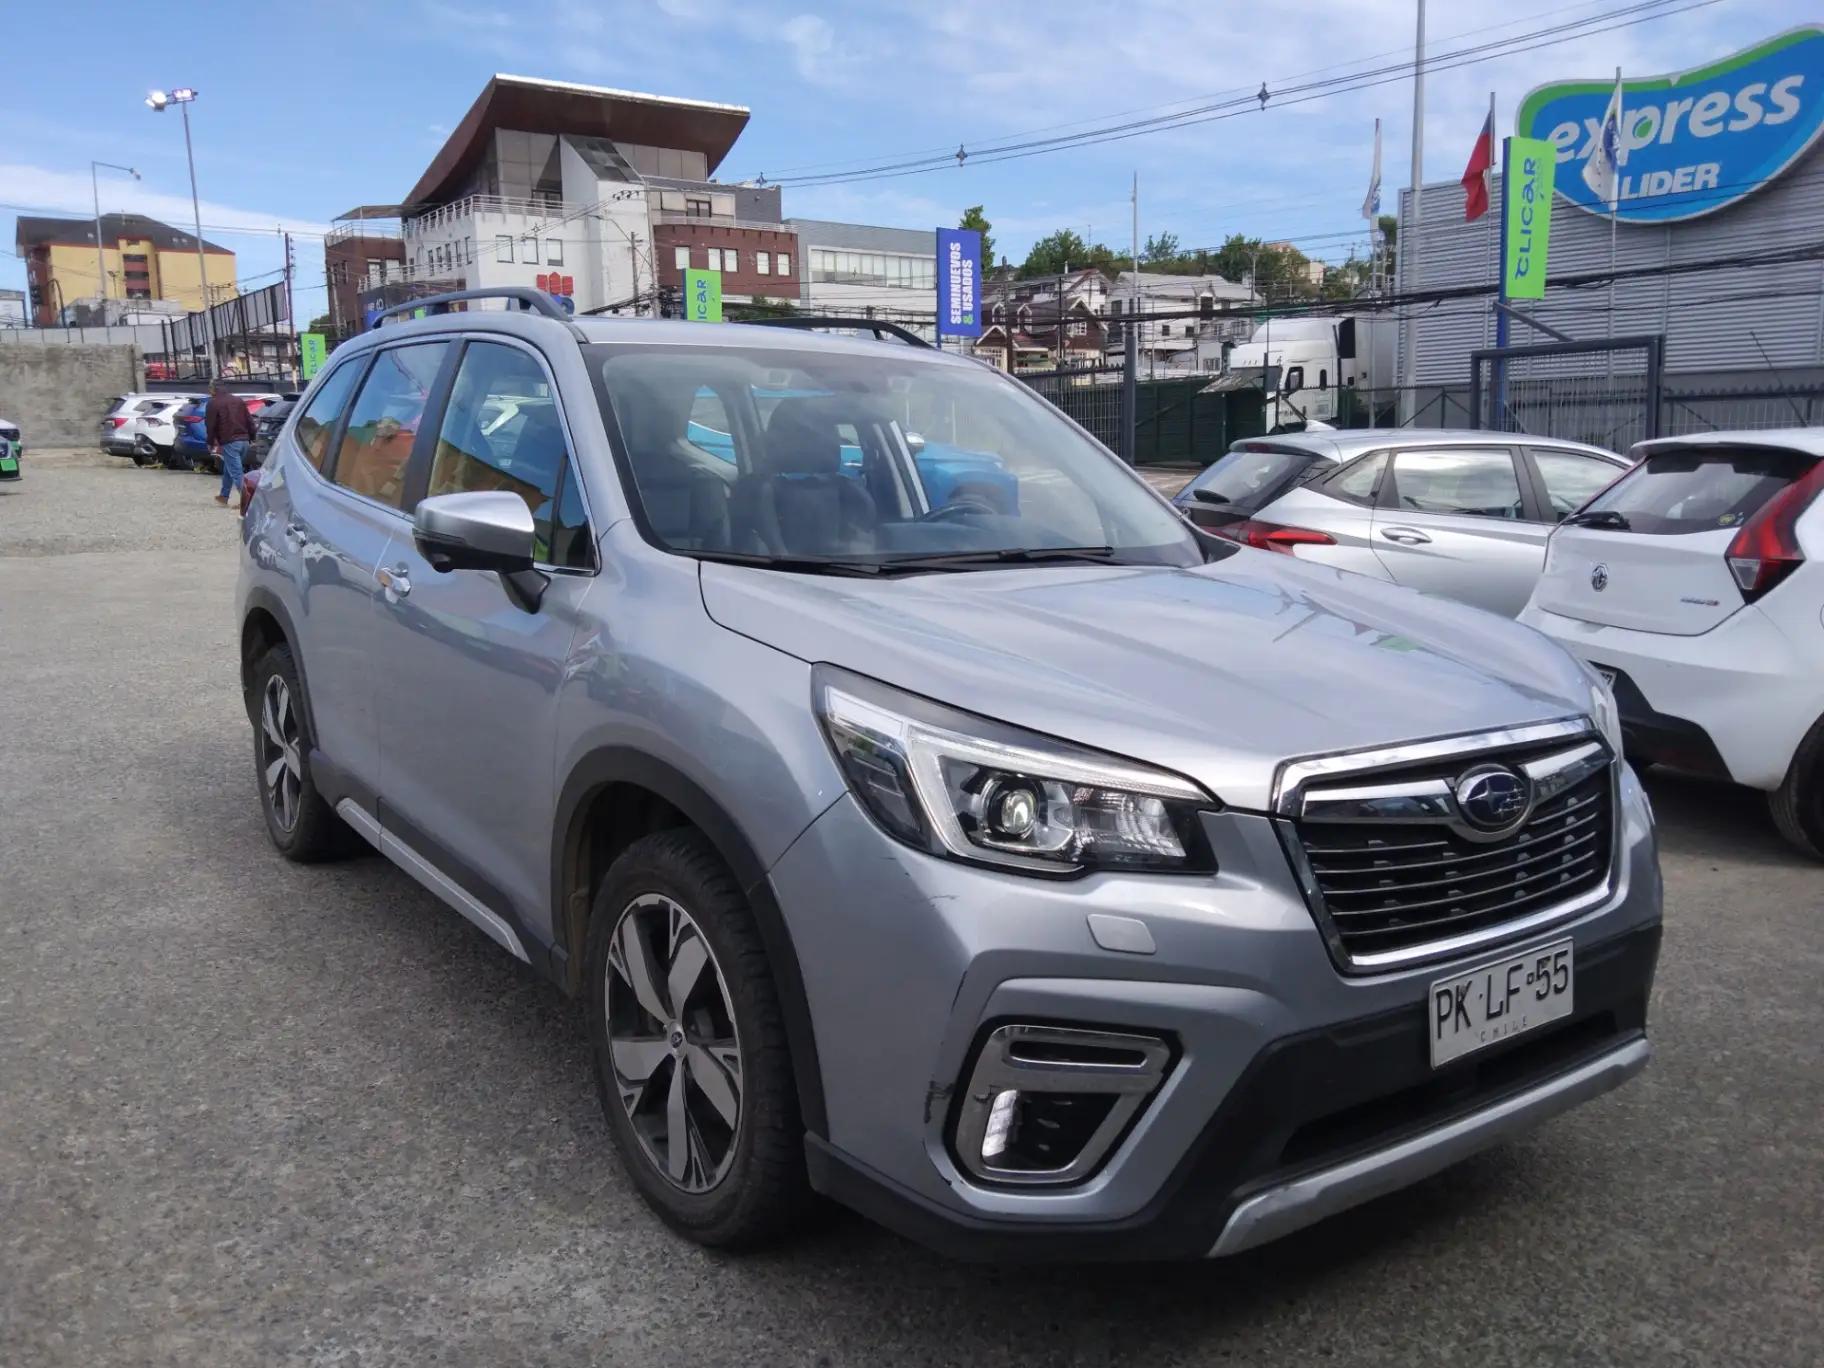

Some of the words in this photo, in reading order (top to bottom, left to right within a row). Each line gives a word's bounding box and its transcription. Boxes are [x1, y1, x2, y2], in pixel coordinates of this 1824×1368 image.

[1549, 75, 1805, 167] express
[1621, 163, 1720, 200] LIDER
[950, 242, 961, 324] SEMINUEVOS
[962, 259, 973, 311] USADOS
[1480, 1015, 1527, 1043] CHILE
